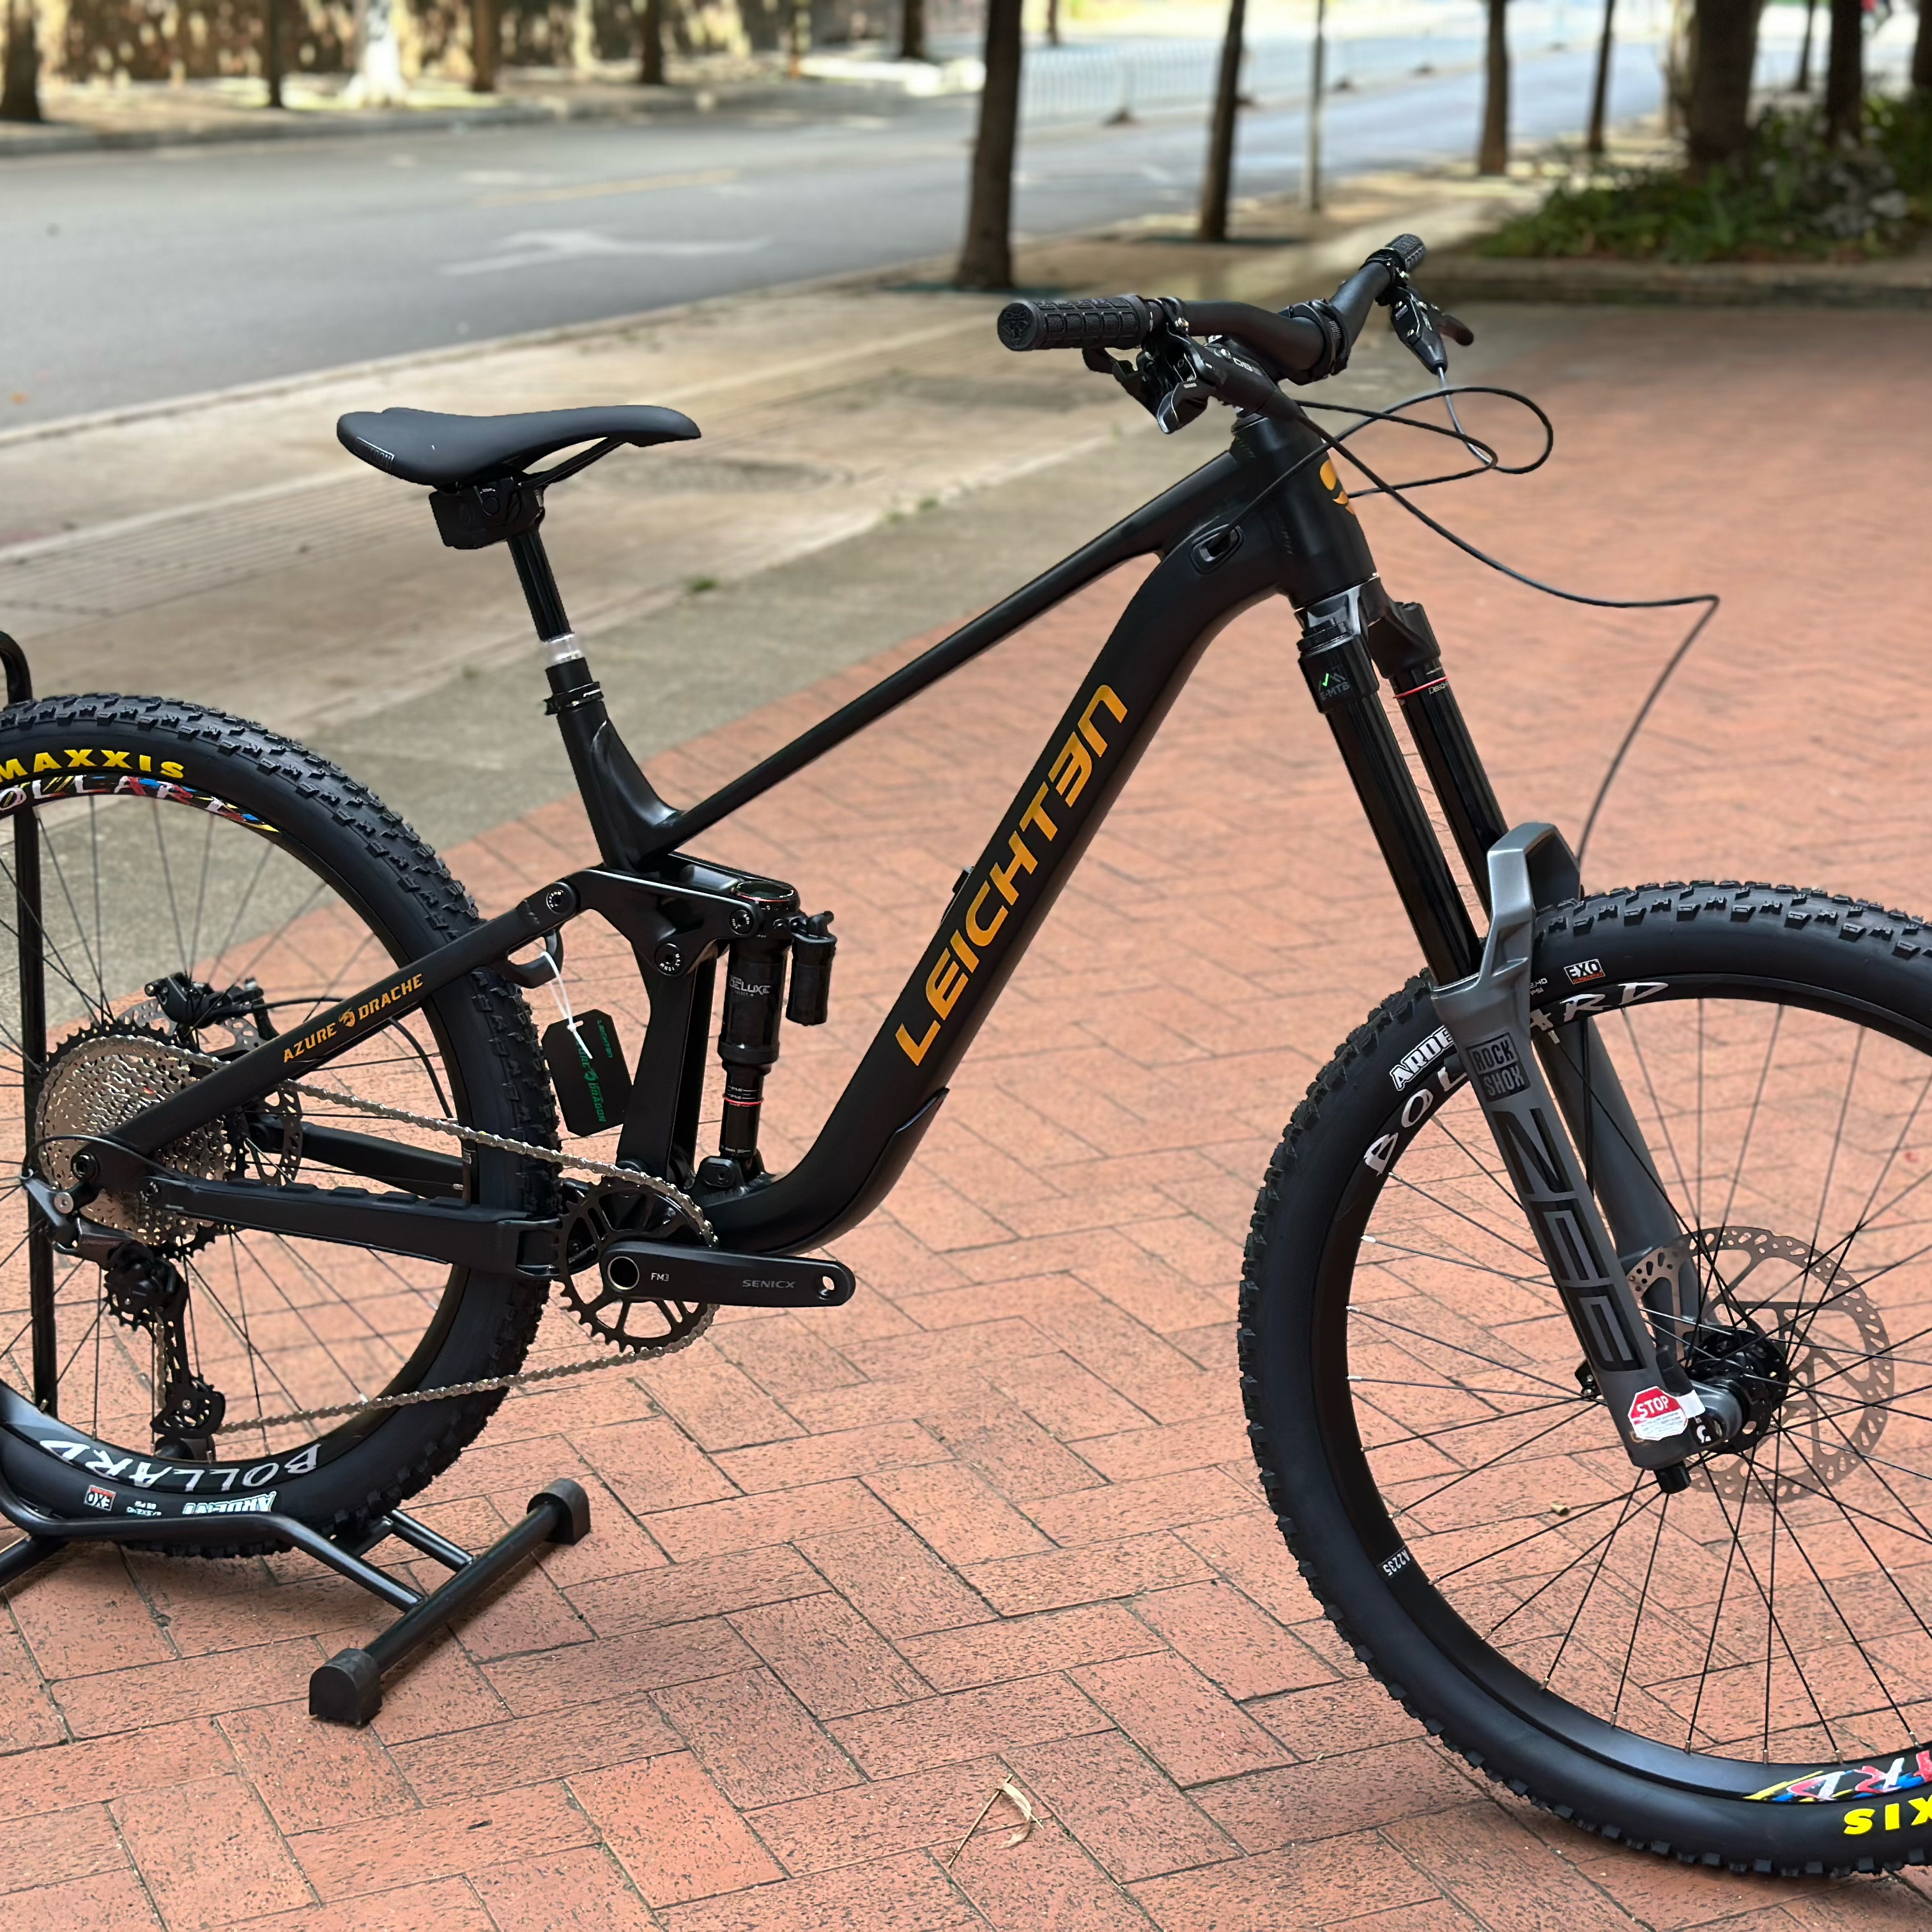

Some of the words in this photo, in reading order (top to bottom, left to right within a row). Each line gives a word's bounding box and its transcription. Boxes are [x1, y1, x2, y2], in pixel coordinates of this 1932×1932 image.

[1319, 682, 1350, 701] E-MTB
[0, 749, 185, 783] MAXXIS
[1566, 960, 1602, 978] EXO
[284, 1022, 337, 1063] AZURE
[358, 973, 424, 1020] DRACHE
[1472, 1039, 1514, 1071] ROCK
[1483, 1065, 1525, 1096] SHOX
[588, 1082, 606, 1123] DRAGON
[650, 1272, 670, 1282] FM3
[742, 1279, 796, 1289] SENICX
[1636, 1395, 1669, 1418] STOP
[40, 1440, 321, 1492] BOLLARD
